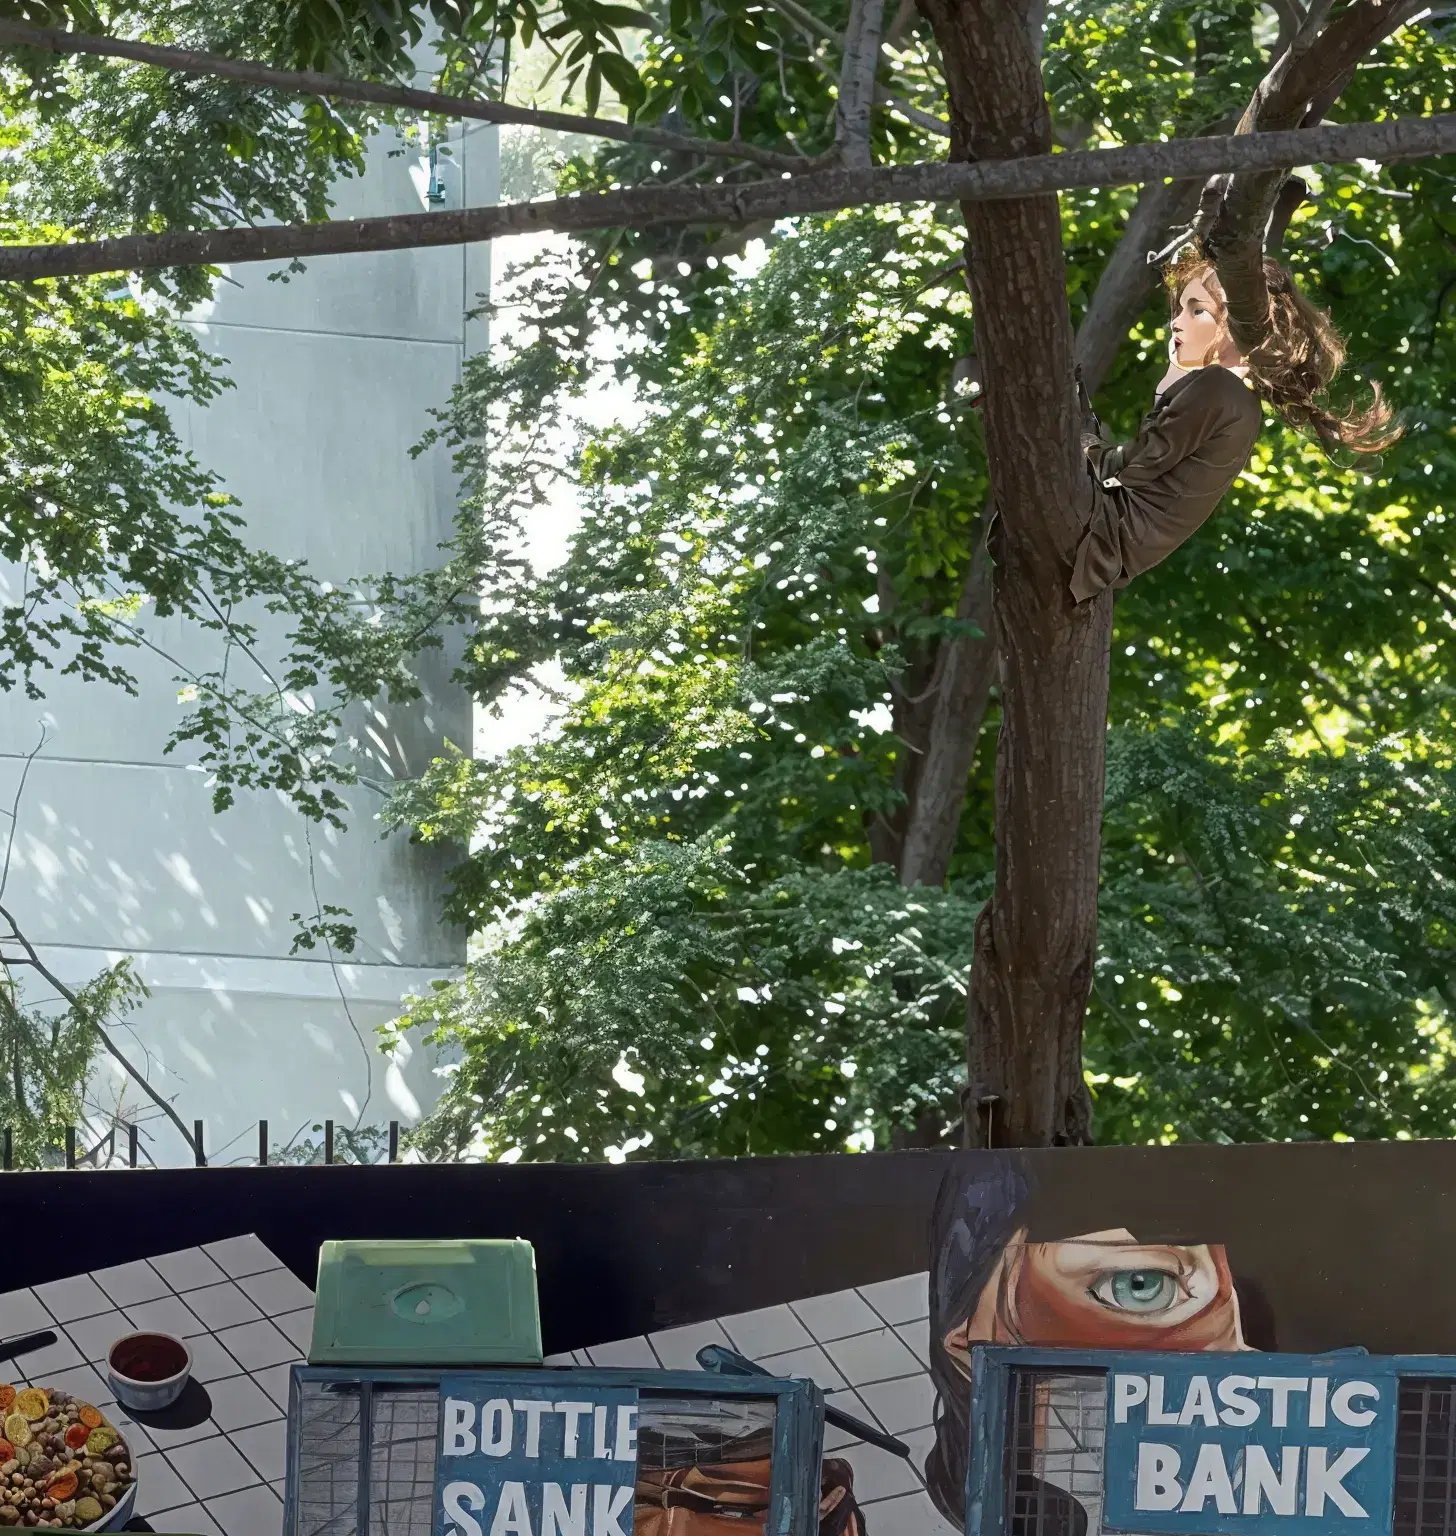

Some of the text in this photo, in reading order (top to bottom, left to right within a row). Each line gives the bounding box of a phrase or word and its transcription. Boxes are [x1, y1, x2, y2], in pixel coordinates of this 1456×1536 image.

[443, 1397, 638, 1461] BOTTLE
[1113, 1374, 1380, 1428] PLASTIC
[1134, 1442, 1371, 1518] BANK
